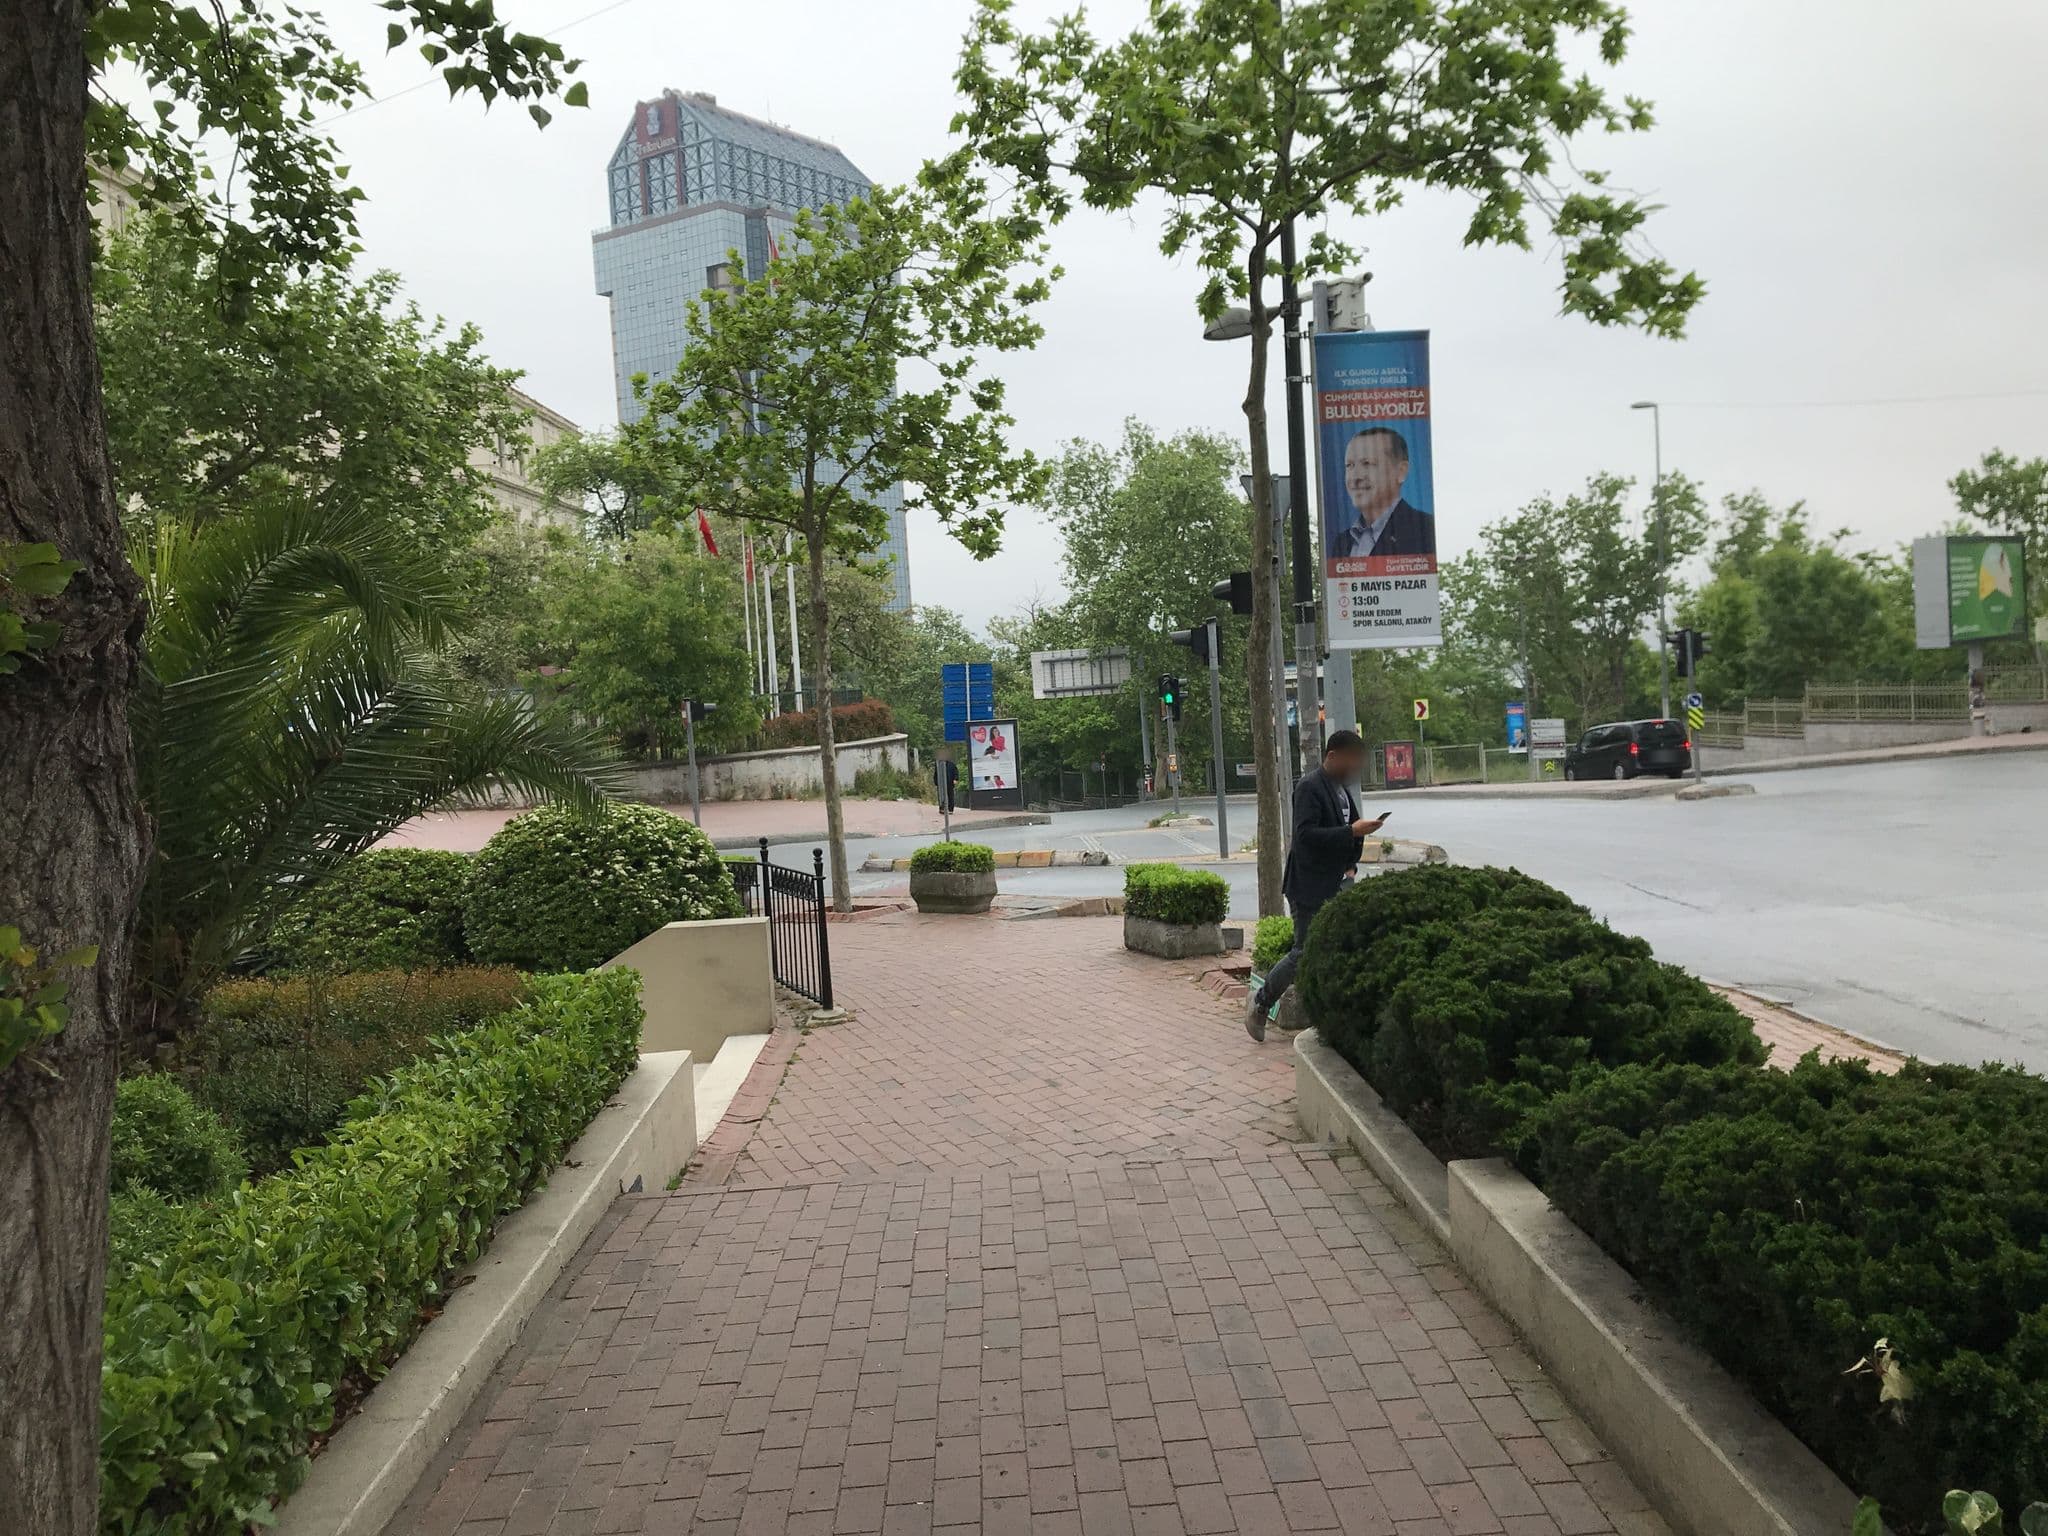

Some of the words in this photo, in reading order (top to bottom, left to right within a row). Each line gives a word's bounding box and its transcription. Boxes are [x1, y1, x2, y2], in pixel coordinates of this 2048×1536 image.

[1325, 402, 1425, 419] BULUŞUYORUZ
[1351, 582, 1358, 592] 6
[1361, 581, 1391, 592] MAYIS
[1395, 579, 1426, 590] PAZAR
[1352, 595, 1379, 606] 13:00
[1376, 608, 1401, 617] ERDEM
[1353, 619, 1372, 628] SPOR
[1374, 618, 1404, 627] SALONU,
[1405, 615, 1432, 625] ATAKÖY
